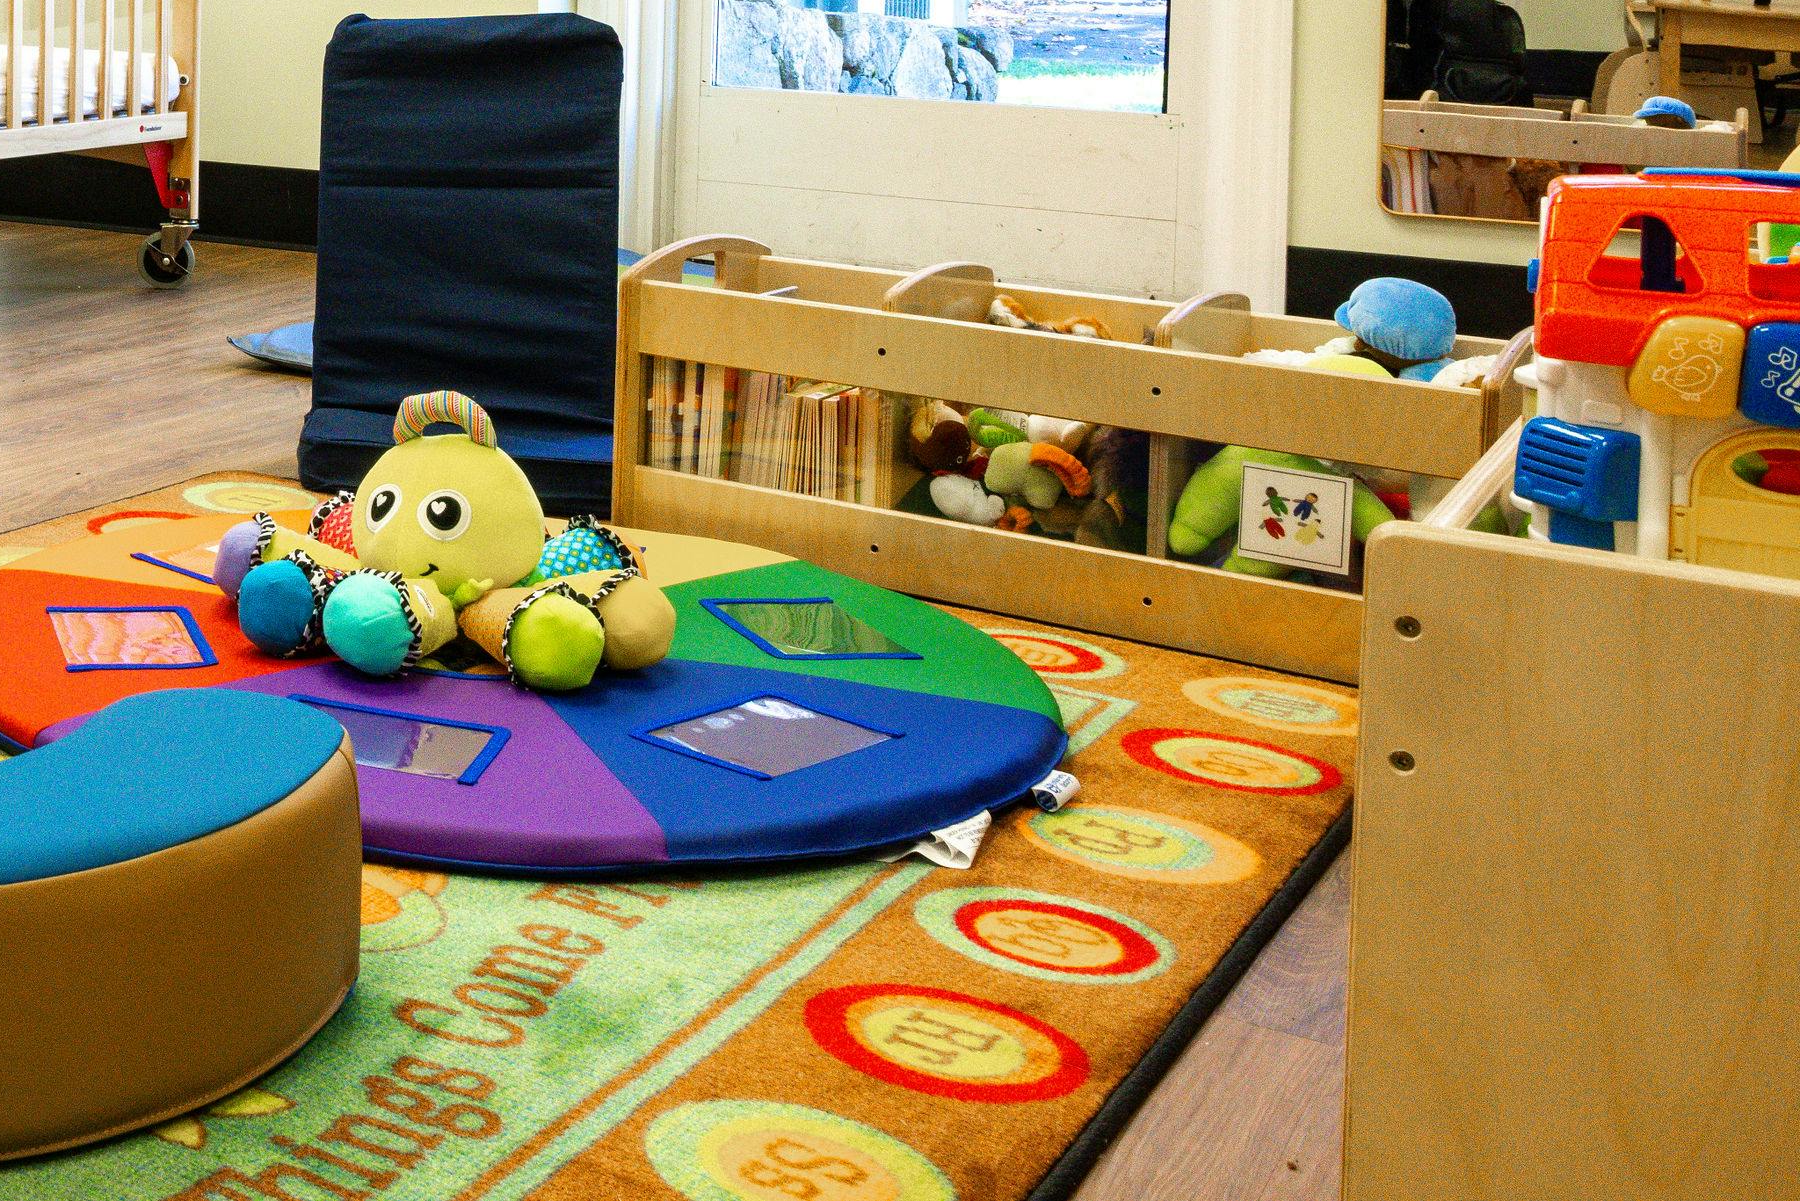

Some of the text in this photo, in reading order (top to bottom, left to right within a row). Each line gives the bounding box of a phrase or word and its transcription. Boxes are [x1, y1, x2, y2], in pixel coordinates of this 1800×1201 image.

[1052, 819, 1169, 856] Pp
[391, 923, 606, 1049] Come
[884, 1010, 1004, 1066] Rr
[738, 1137, 870, 1201] Ss
